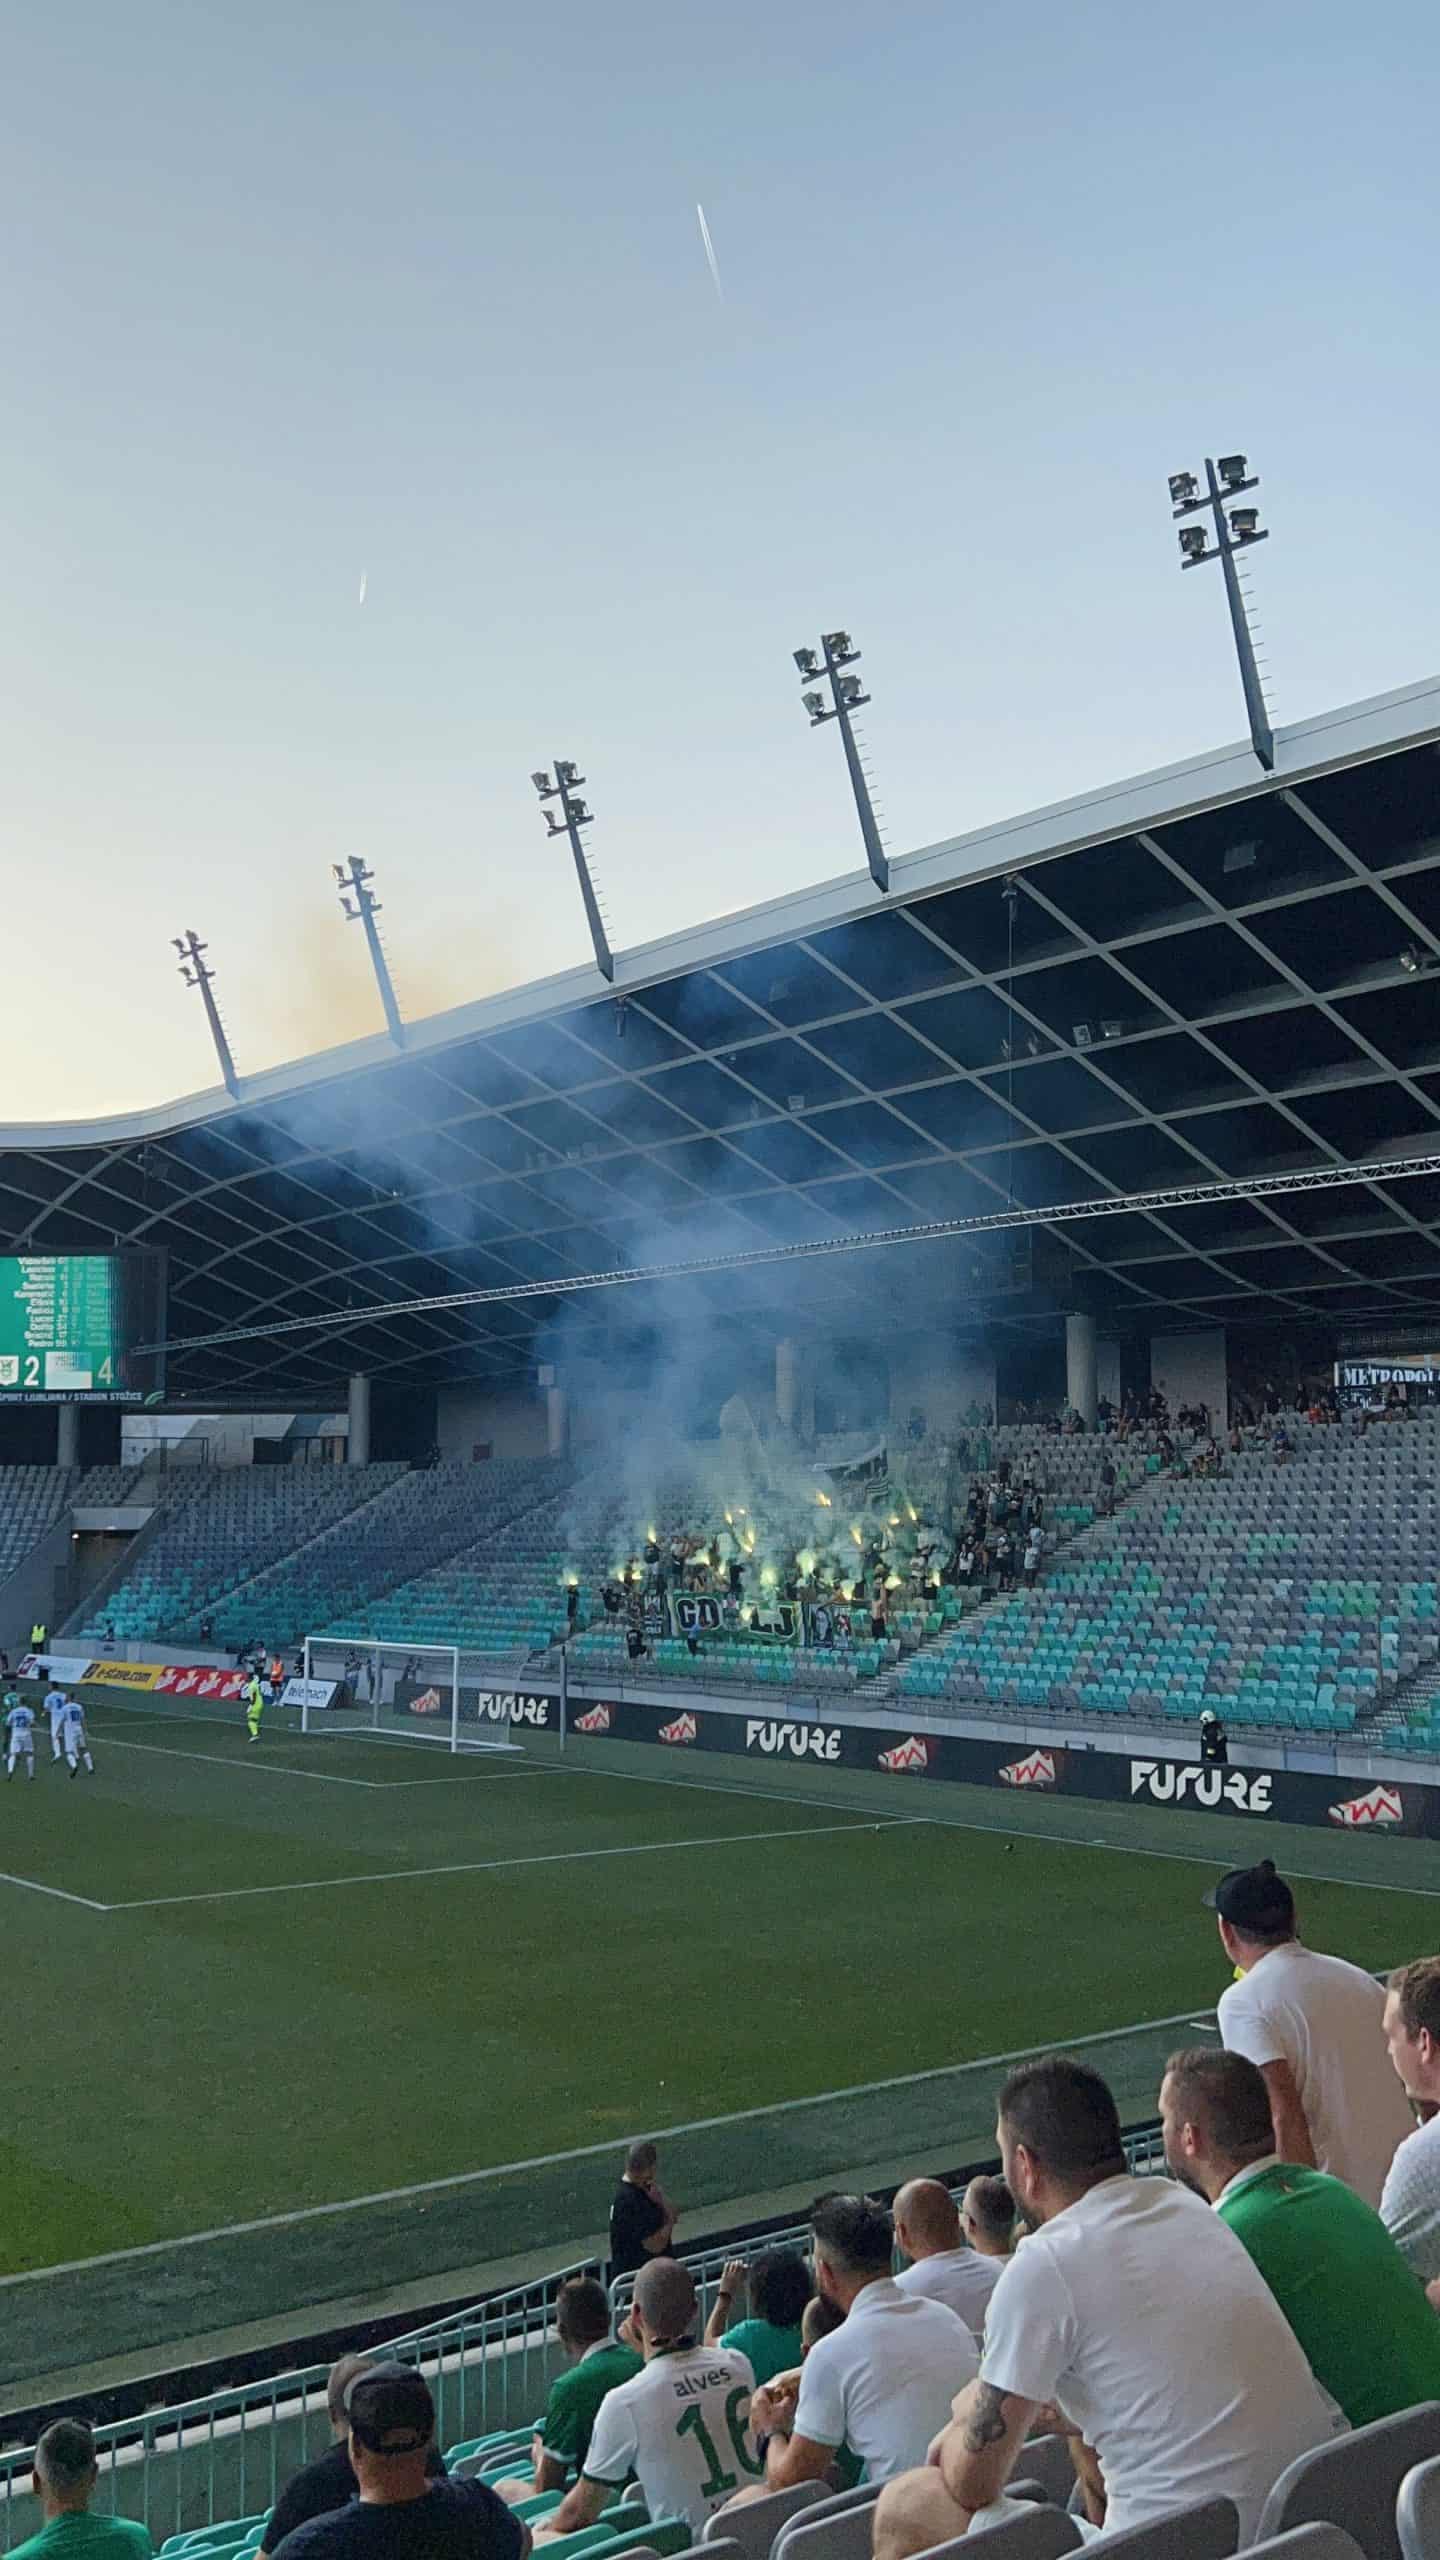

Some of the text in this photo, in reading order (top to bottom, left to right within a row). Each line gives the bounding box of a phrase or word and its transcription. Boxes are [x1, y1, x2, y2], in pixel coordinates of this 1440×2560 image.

[24, 1355, 114, 1387] 2 4
[478, 1692, 549, 1725] FUTURE
[746, 1719, 842, 1760] FUTURE
[1130, 1760, 1273, 1812] FUTURE
[673, 2367, 731, 2398] alves
